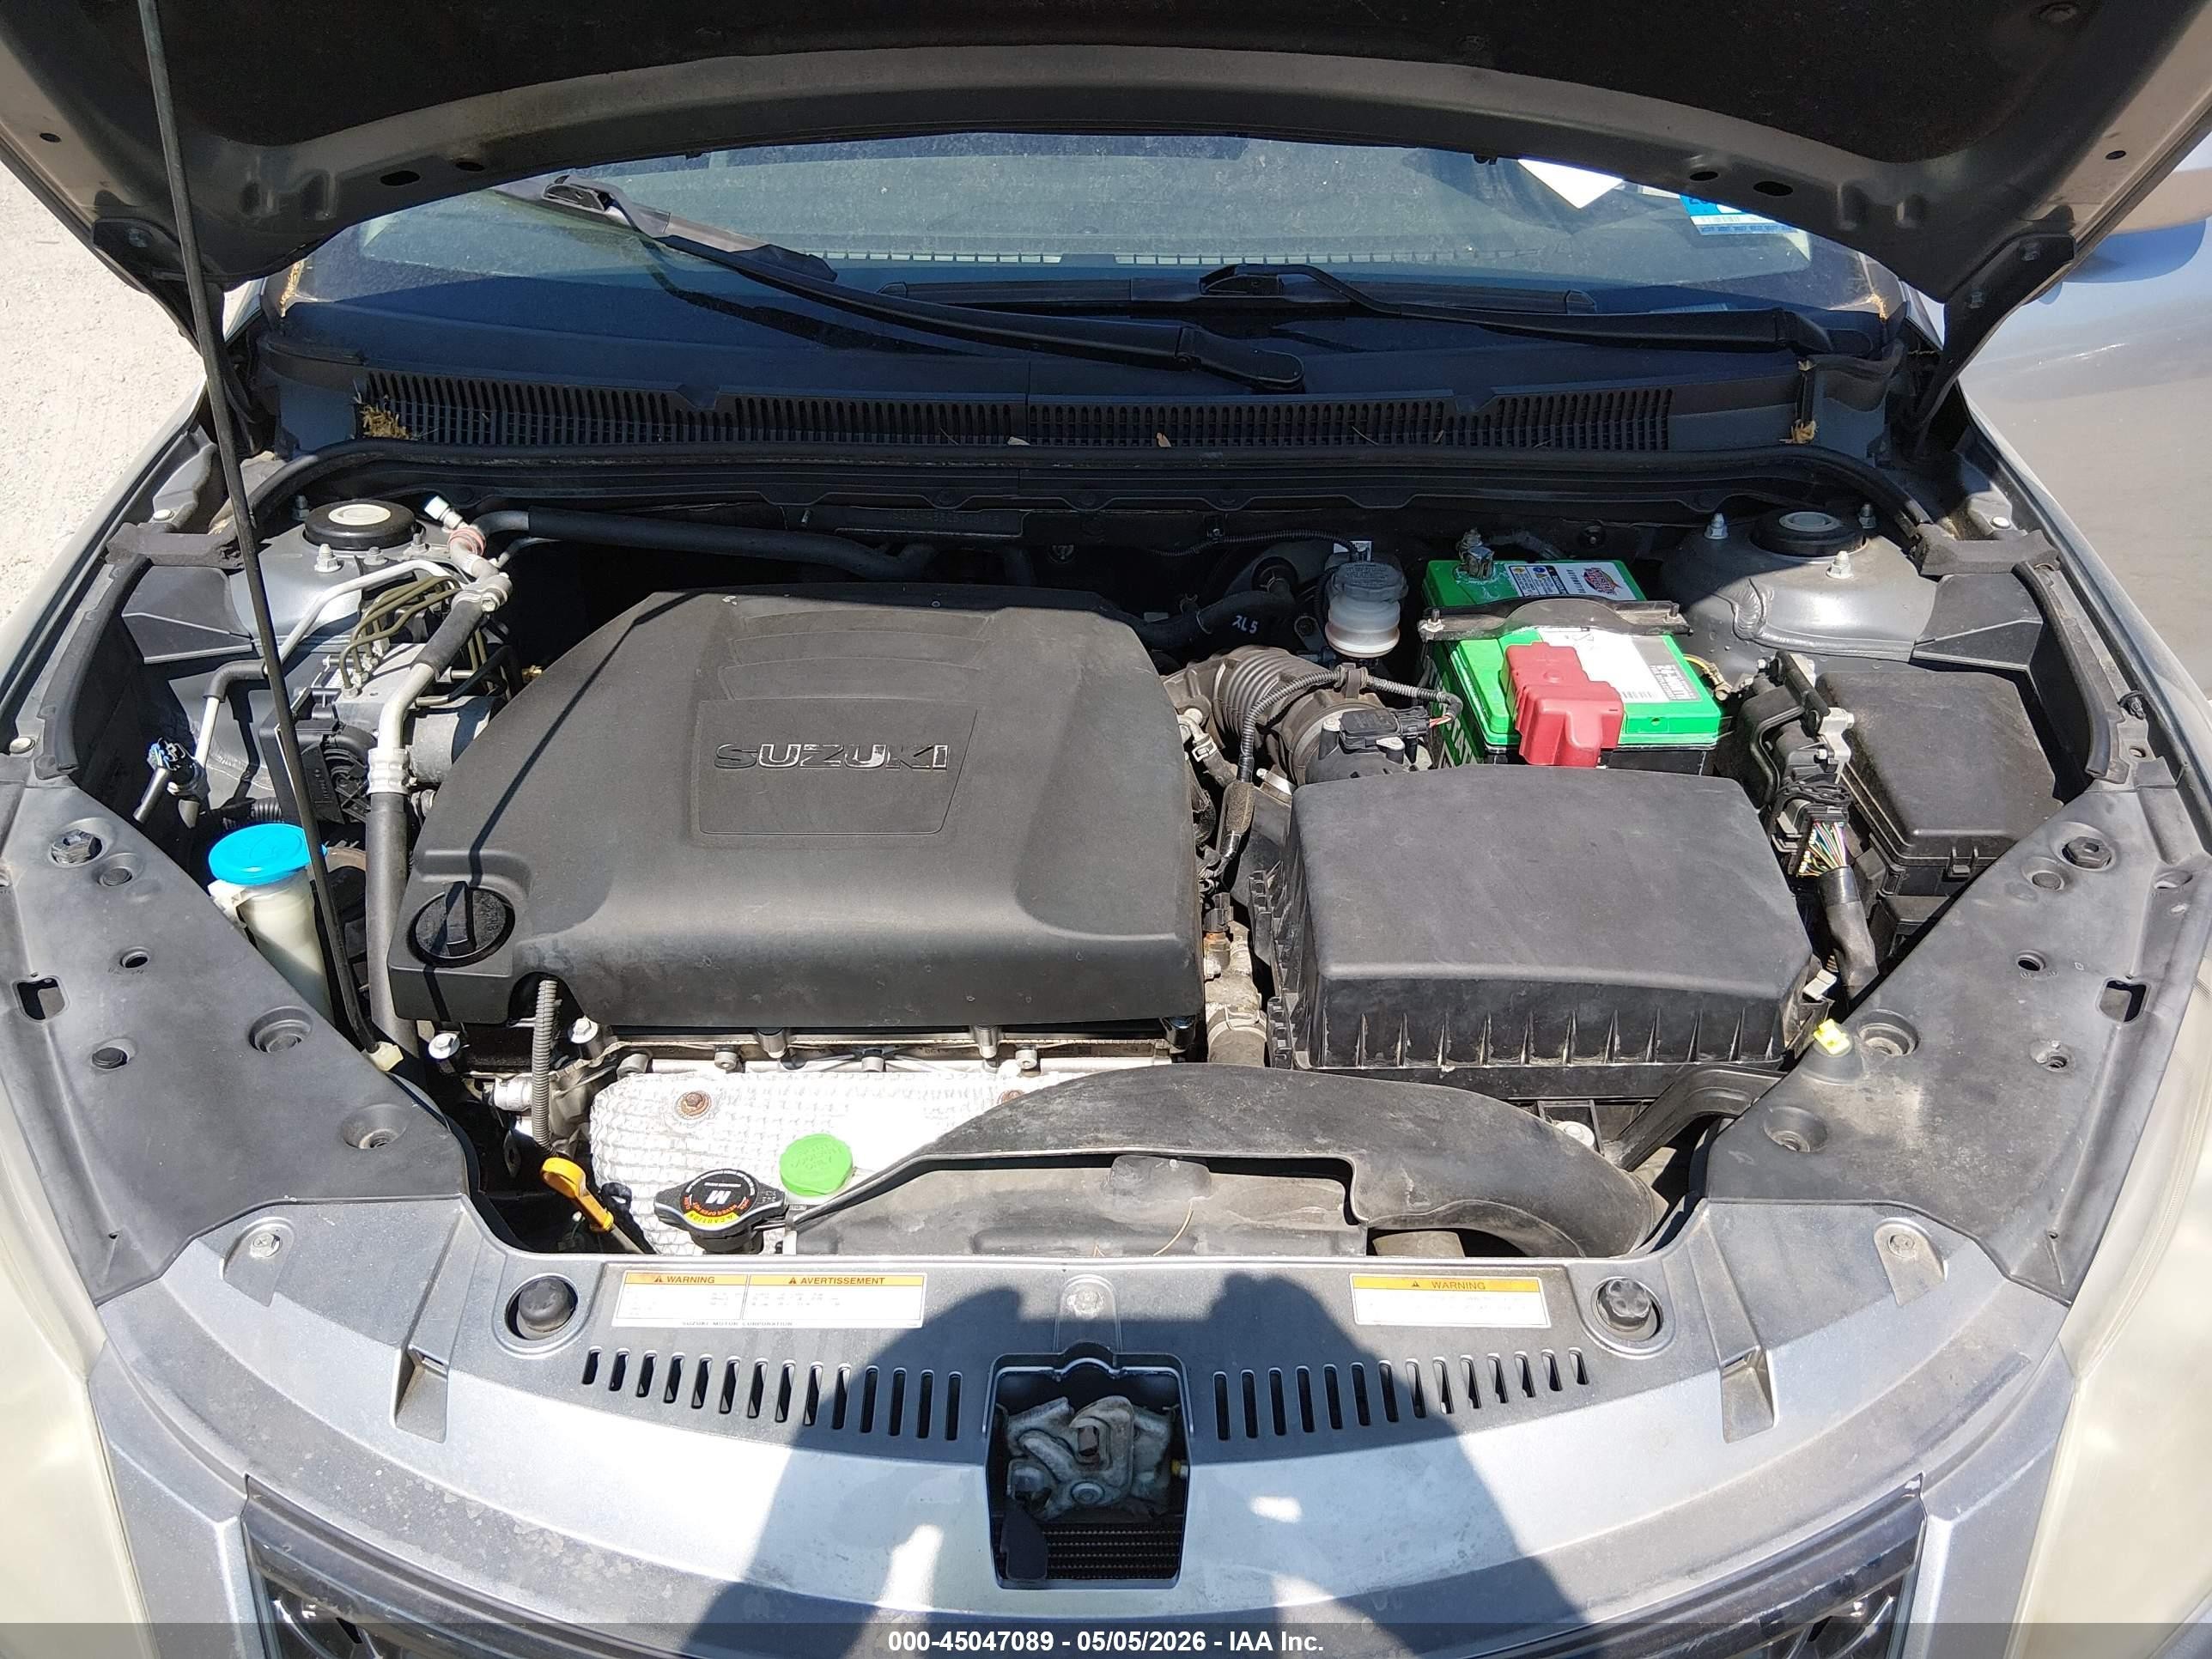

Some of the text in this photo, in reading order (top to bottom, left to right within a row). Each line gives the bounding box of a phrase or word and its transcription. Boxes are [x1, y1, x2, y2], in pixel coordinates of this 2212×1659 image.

[714, 744, 950, 771] SUZUKI
[689, 1212, 726, 1224] CAUTION
[799, 1277, 885, 1285] AVERTISSEMENT
[1431, 1281, 1486, 1290] WARNING
